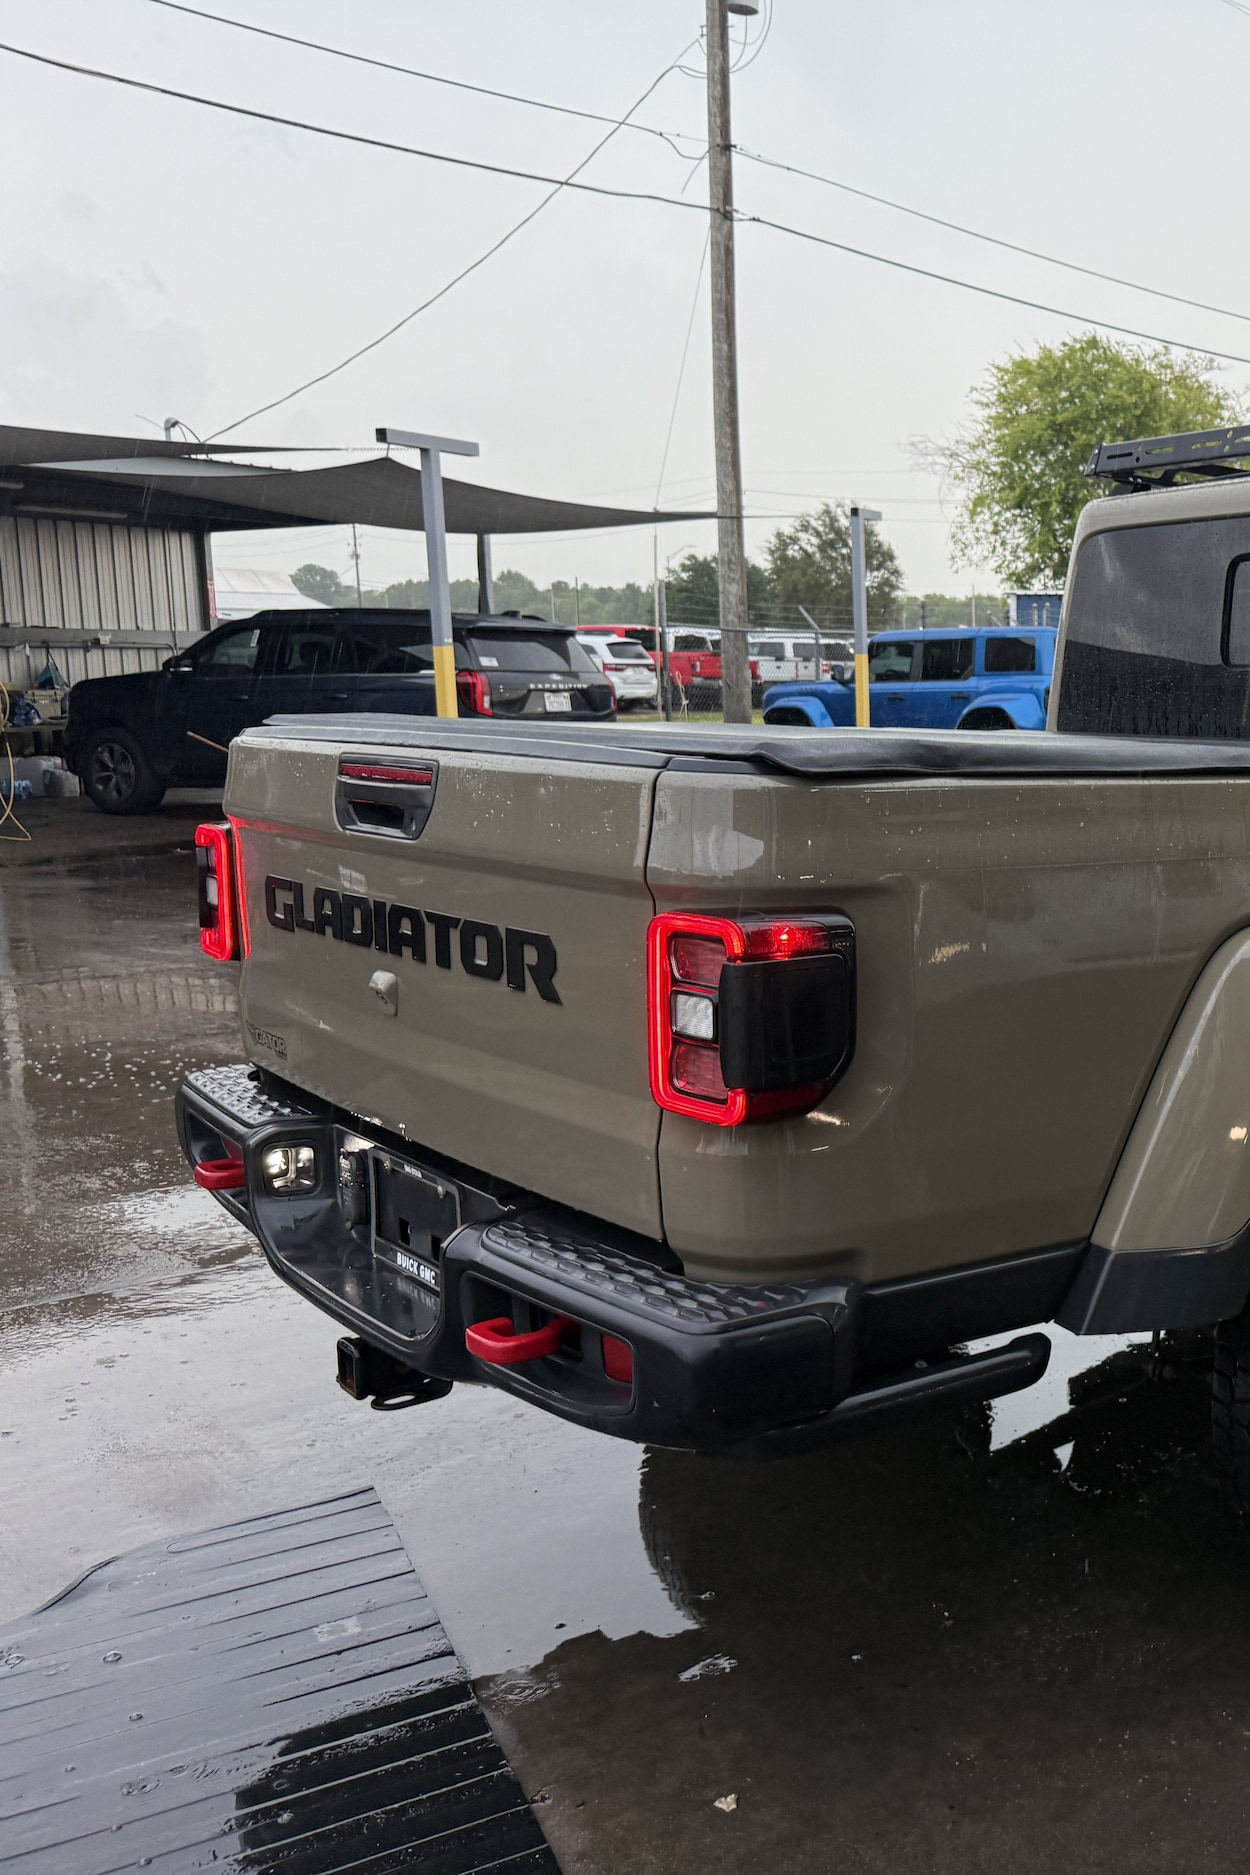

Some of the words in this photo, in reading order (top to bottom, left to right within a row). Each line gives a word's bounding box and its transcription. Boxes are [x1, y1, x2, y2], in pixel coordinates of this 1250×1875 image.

[265, 873, 563, 1006] GLADIATOR
[396, 1251, 419, 1275] BUICK
[419, 1264, 436, 1285] GMC
